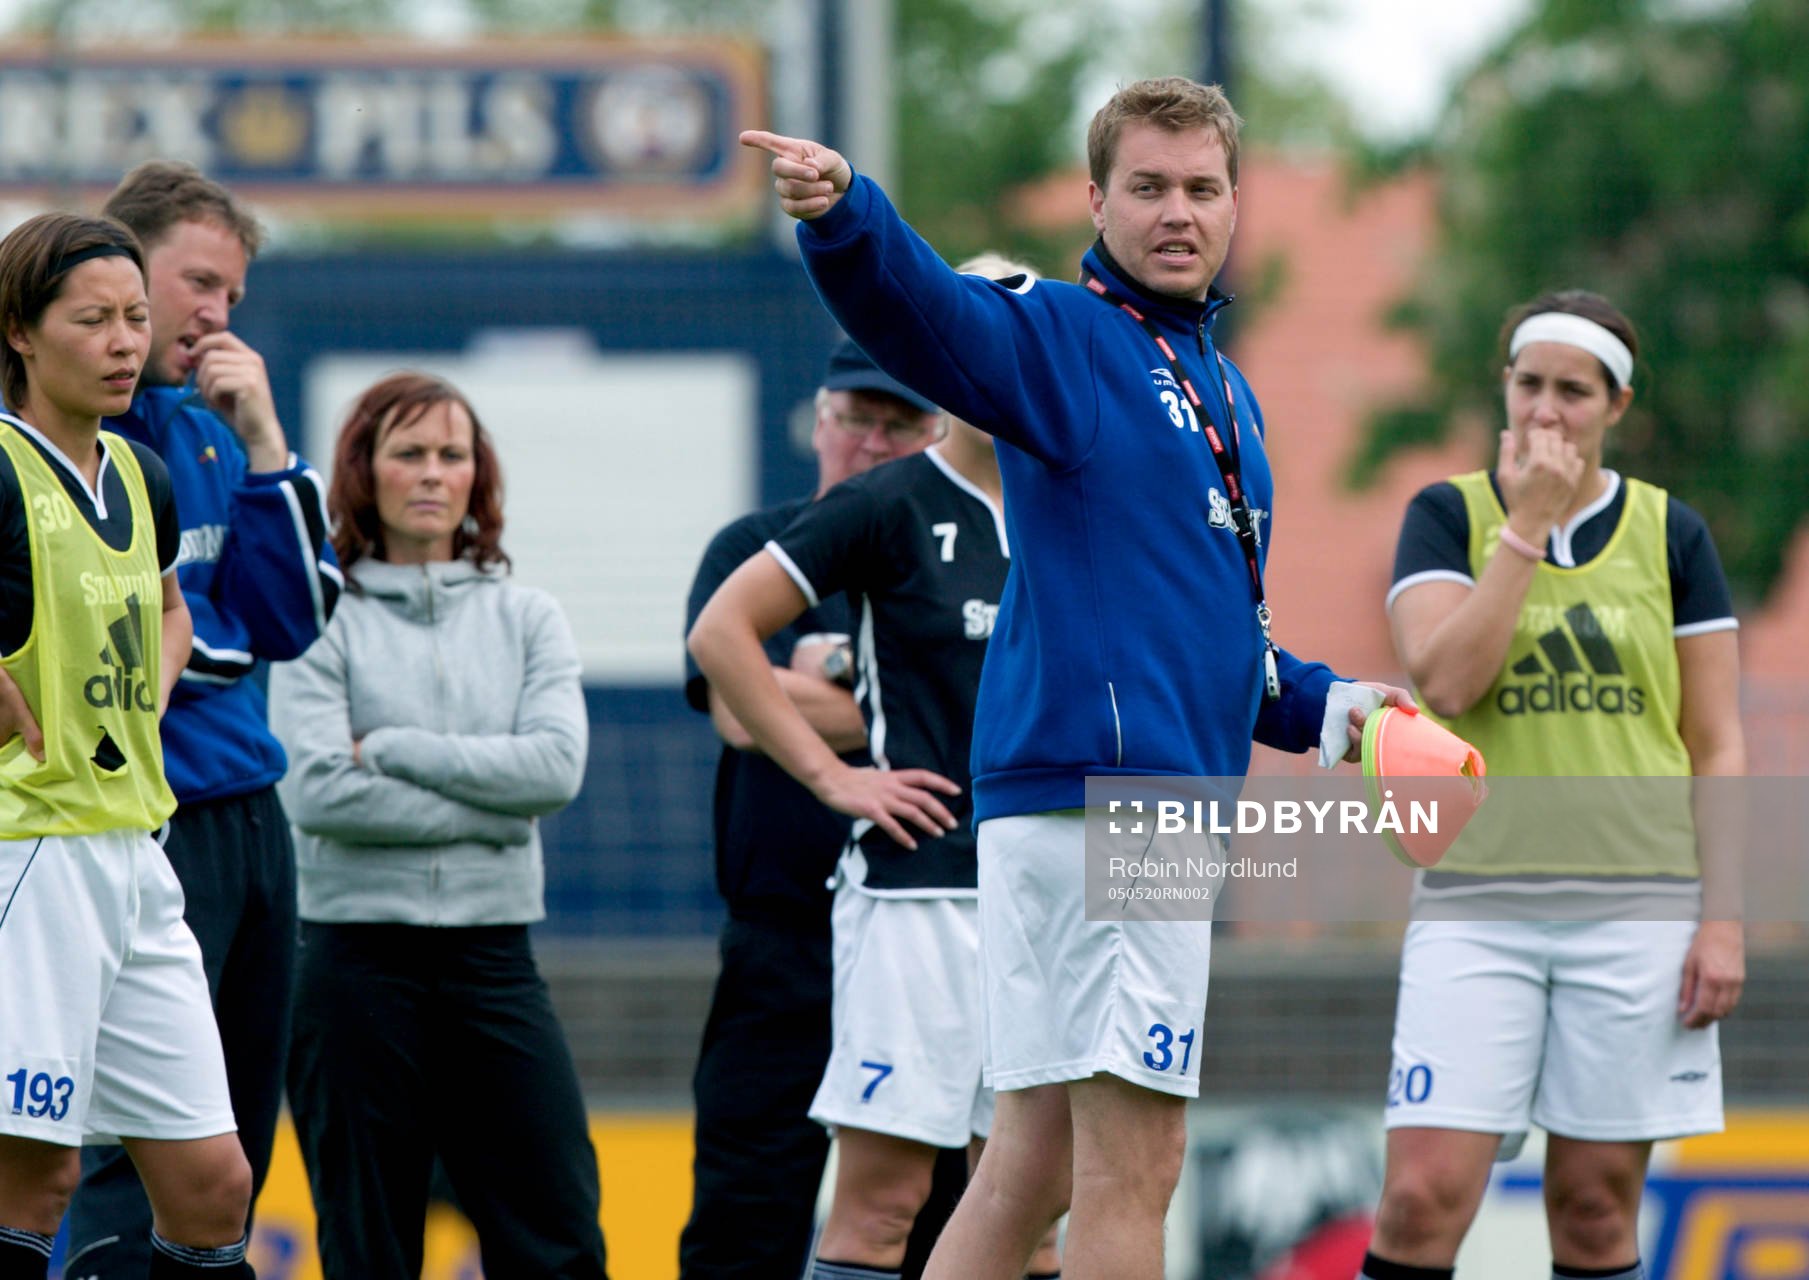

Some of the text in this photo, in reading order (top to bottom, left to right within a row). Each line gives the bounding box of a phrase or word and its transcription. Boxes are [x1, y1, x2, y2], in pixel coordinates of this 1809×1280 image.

[316, 74, 556, 178] PILS
[1160, 391, 1199, 432] 31
[33, 491, 72, 533] 30
[932, 522, 958, 562] 7
[1498, 674, 1645, 716] adidas
[1143, 1023, 1195, 1076] 31
[6, 1067, 75, 1121] 193
[861, 1061, 893, 1104] 7
